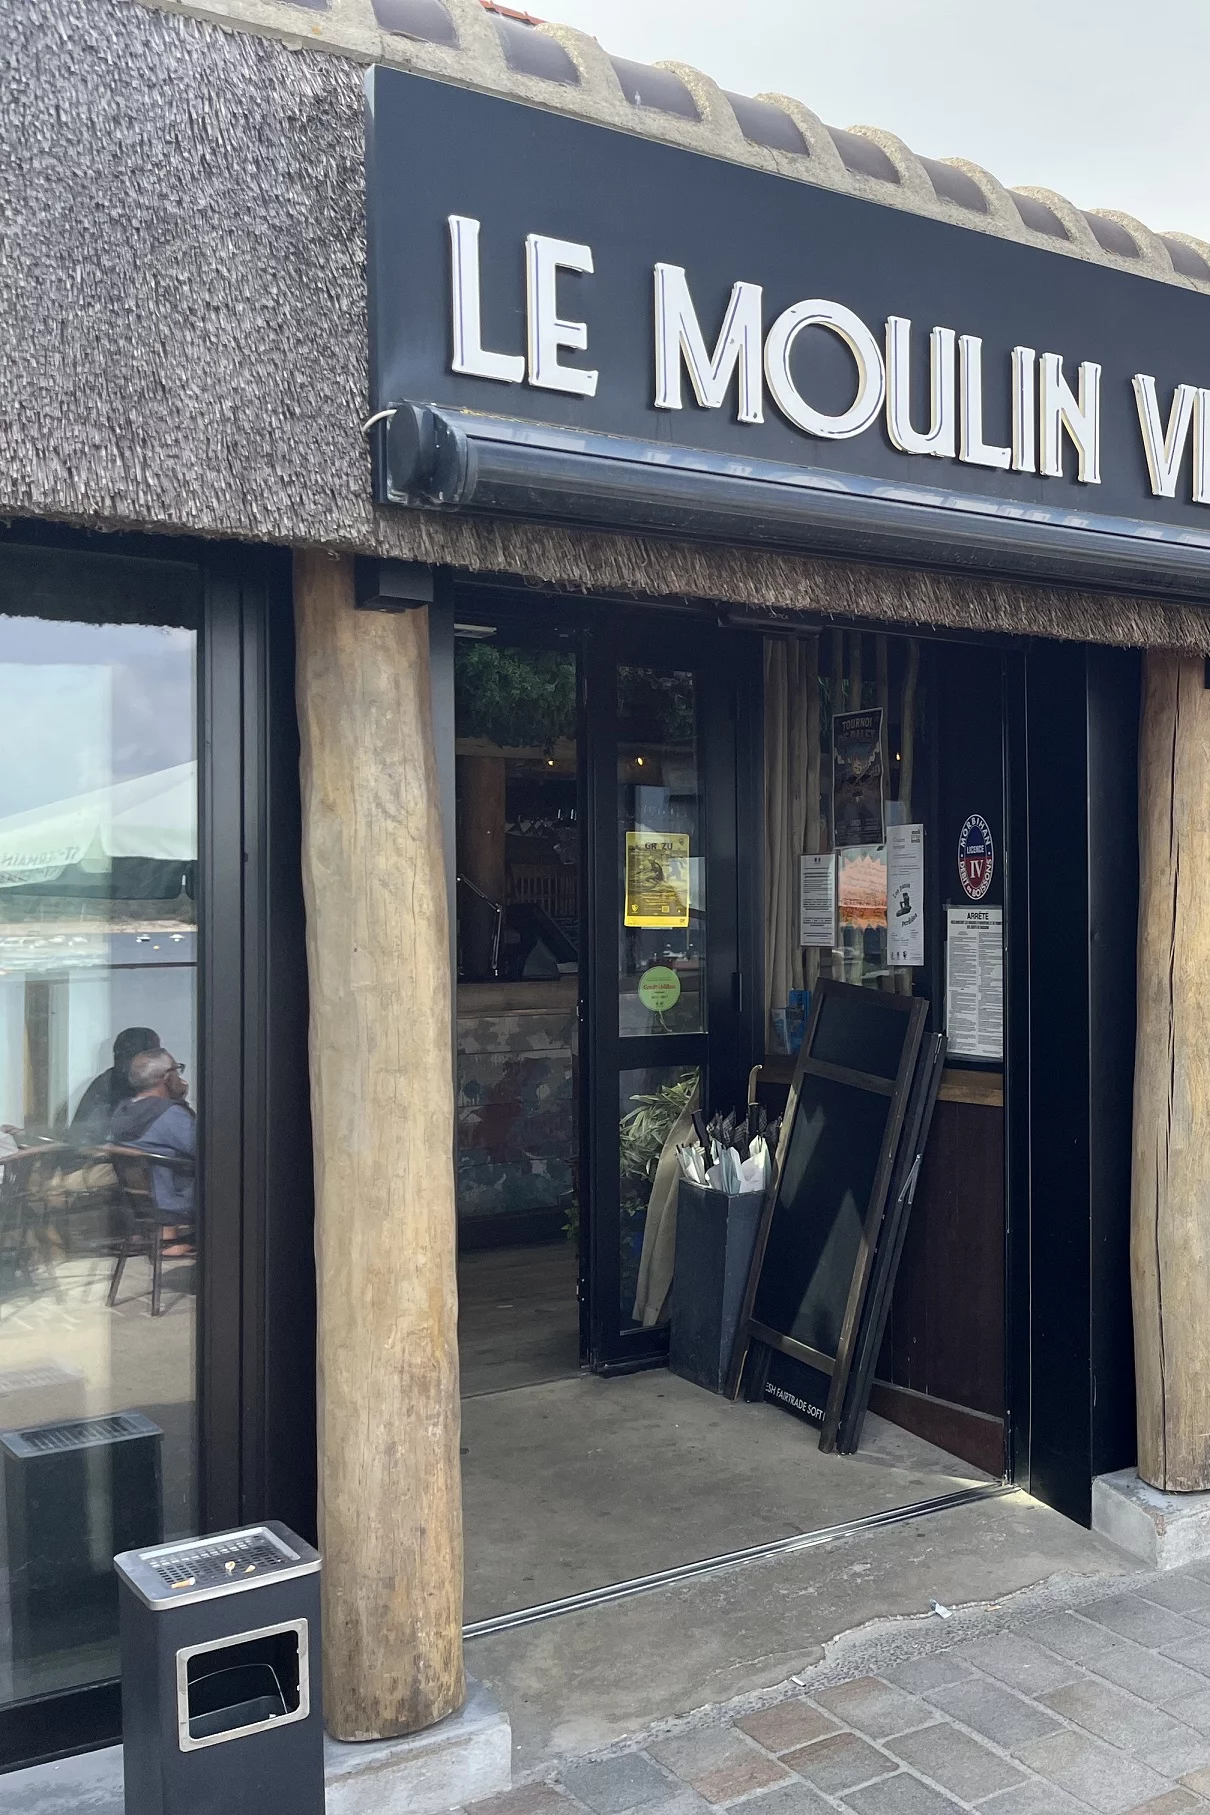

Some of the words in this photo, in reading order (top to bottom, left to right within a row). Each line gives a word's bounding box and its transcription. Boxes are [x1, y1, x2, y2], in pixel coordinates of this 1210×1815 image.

[448, 214, 598, 397] LE
[654, 262, 1101, 484] MOULIN
[842, 717, 873, 731] TOURNOI
[960, 817, 991, 847] MORBIHAN
[966, 844, 985, 854] LICENCE
[969, 859, 984, 879] IV
[971, 859, 992, 897] BOISSONS
[776, 1388, 807, 1412] FAIRTRADE
[806, 1404, 824, 1420] SOFT
